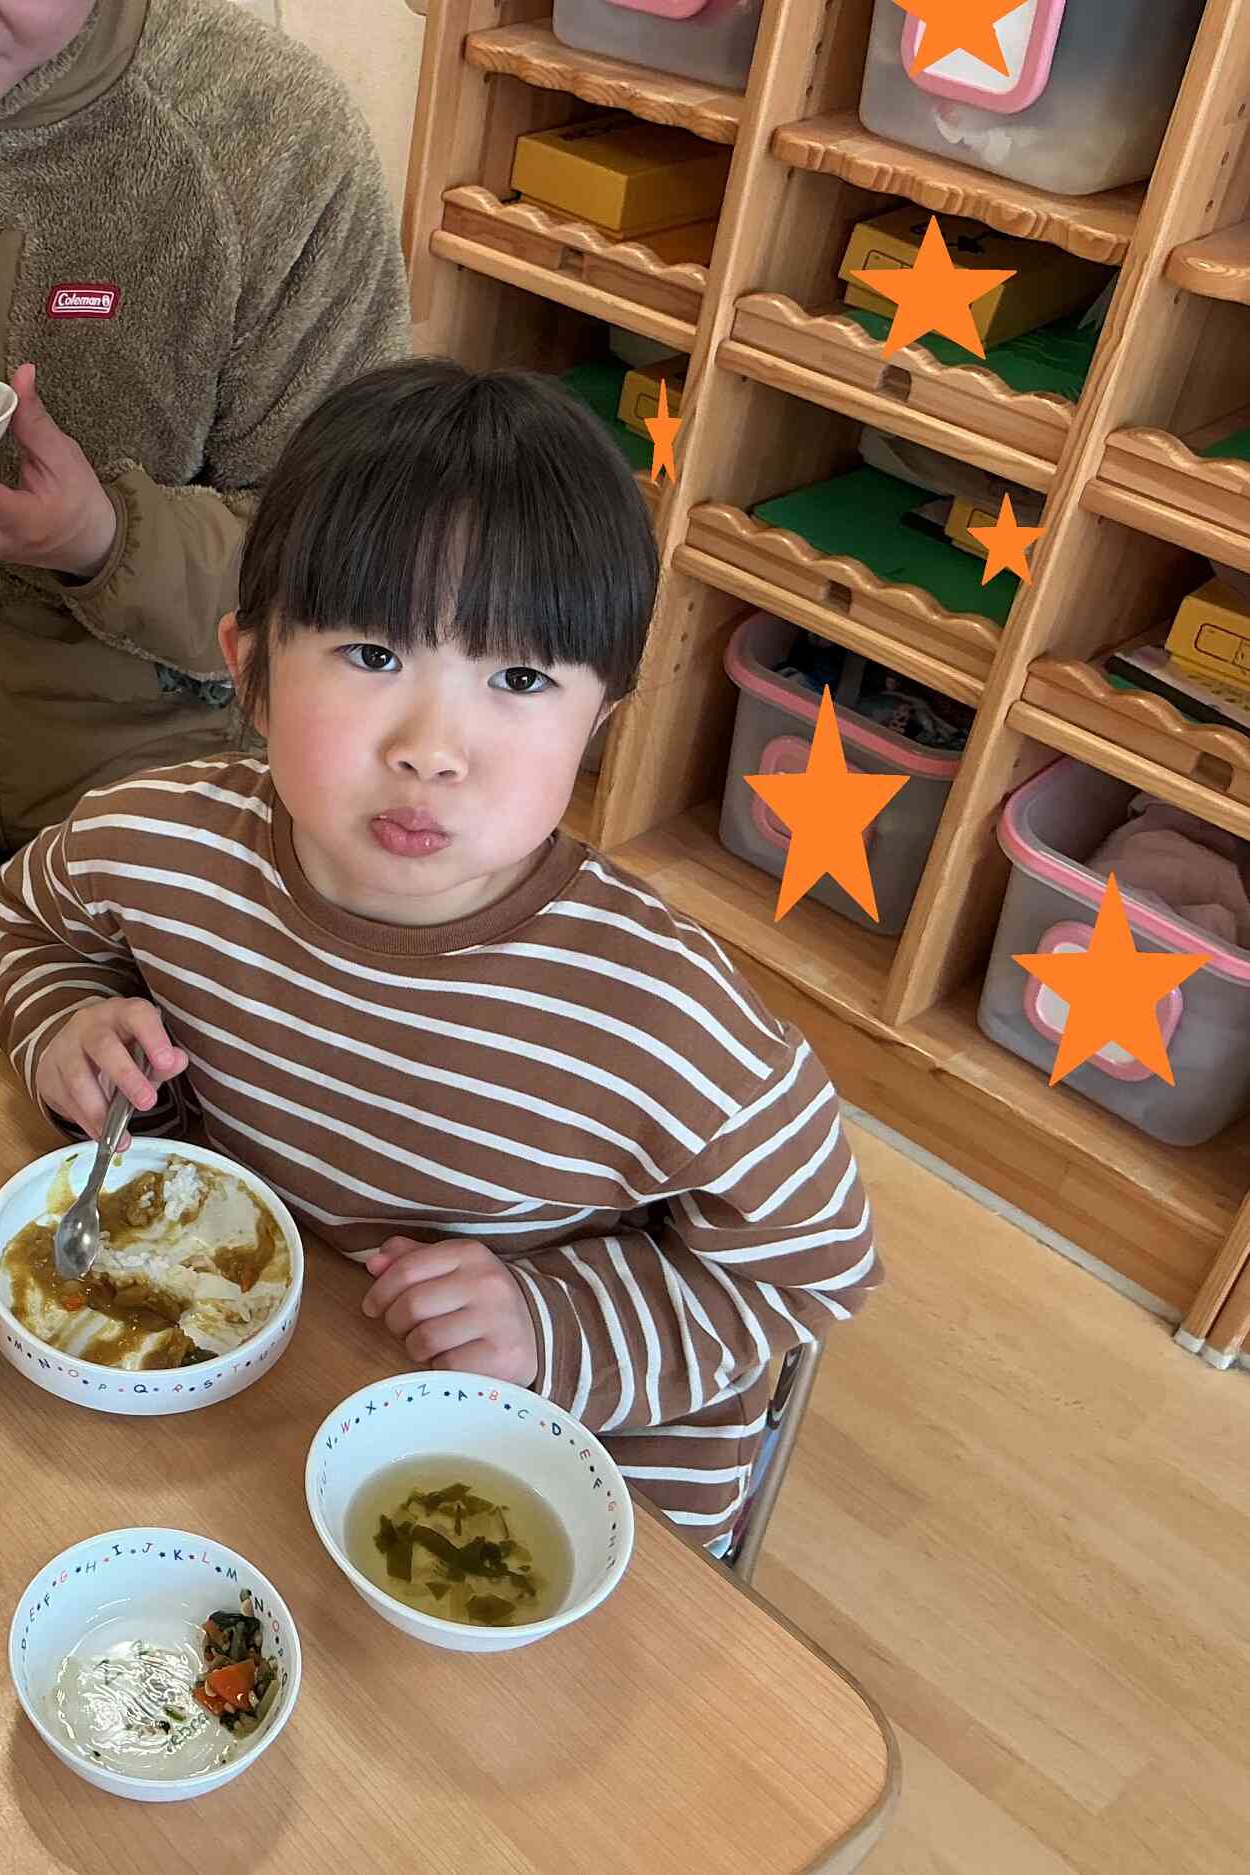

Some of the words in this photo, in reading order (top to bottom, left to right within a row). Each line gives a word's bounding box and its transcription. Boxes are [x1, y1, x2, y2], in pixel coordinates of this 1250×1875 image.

[58, 293, 101, 306] Coleman
[38, 1358, 51, 1370] N
[68, 1368, 80, 1378] O
[98, 1383, 108, 1392] P
[133, 1383, 149, 1394] Q
[172, 1383, 184, 1393] R
[203, 1379, 214, 1389] S
[340, 1421, 352, 1434] W
[366, 1400, 377, 1415] X
[394, 1389, 404, 1399] Y
[417, 1384, 431, 1397] Z
[457, 1389, 468, 1401] A
[488, 1390, 500, 1401] B
[517, 1408, 530, 1420] C
[551, 1422, 562, 1436] D
[579, 1448, 592, 1460] E
[592, 1478, 603, 1490] F
[29, 1608, 36, 1622] E
[44, 1595, 52, 1608] F
[59, 1572, 68, 1584] G
[86, 1561, 97, 1573] H
[113, 1544, 123, 1556] I
[142, 1542, 154, 1554] J
[173, 1549, 183, 1561] K
[201, 1552, 210, 1564] L
[226, 1568, 238, 1580] M
[254, 1599, 264, 1611] N
[272, 1620, 280, 1632] O
